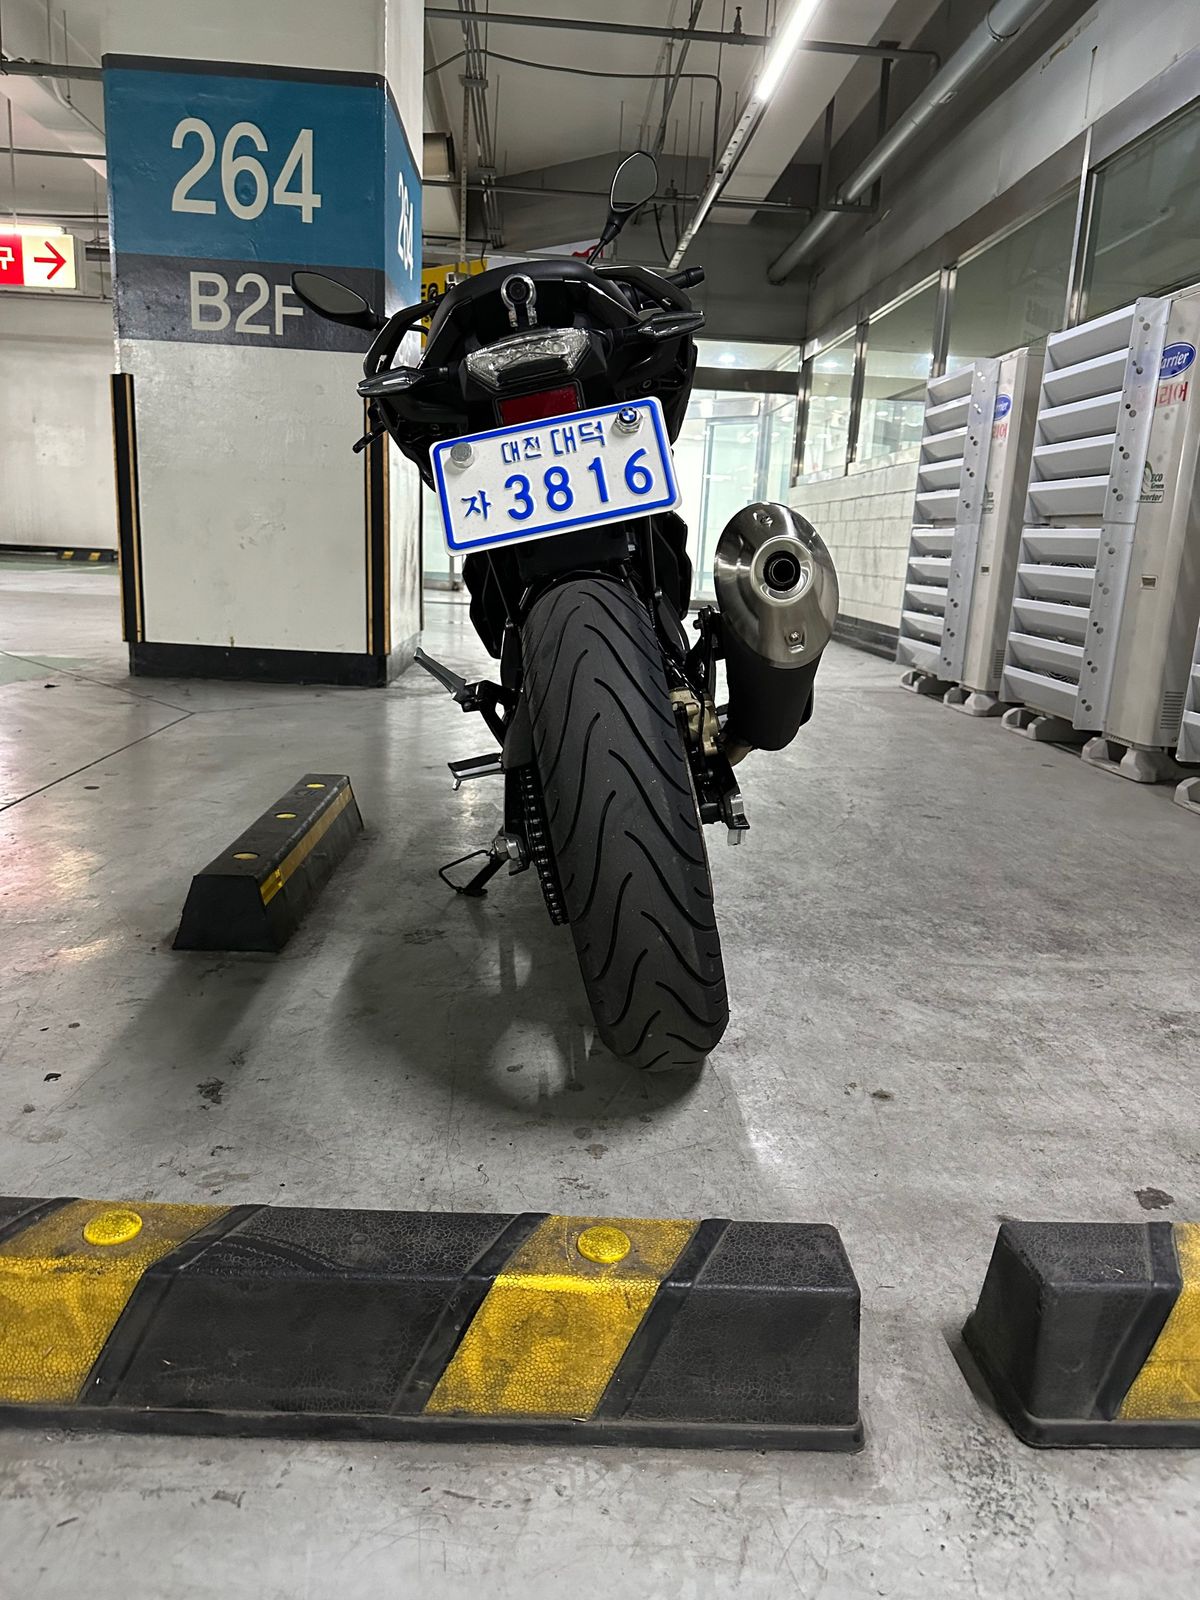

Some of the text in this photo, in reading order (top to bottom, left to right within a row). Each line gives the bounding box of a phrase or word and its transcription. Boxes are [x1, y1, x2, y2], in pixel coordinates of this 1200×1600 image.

[171, 117, 322, 224] 264
[398, 171, 414, 281] 264
[189, 271, 304, 336] B2F
[1160, 351, 1189, 370] arrier
[1158, 381, 1188, 405] 리어
[501, 420, 606, 464] 대전 대덕
[461, 448, 654, 521] 자 3816
[1140, 493, 1162, 501] nverter
